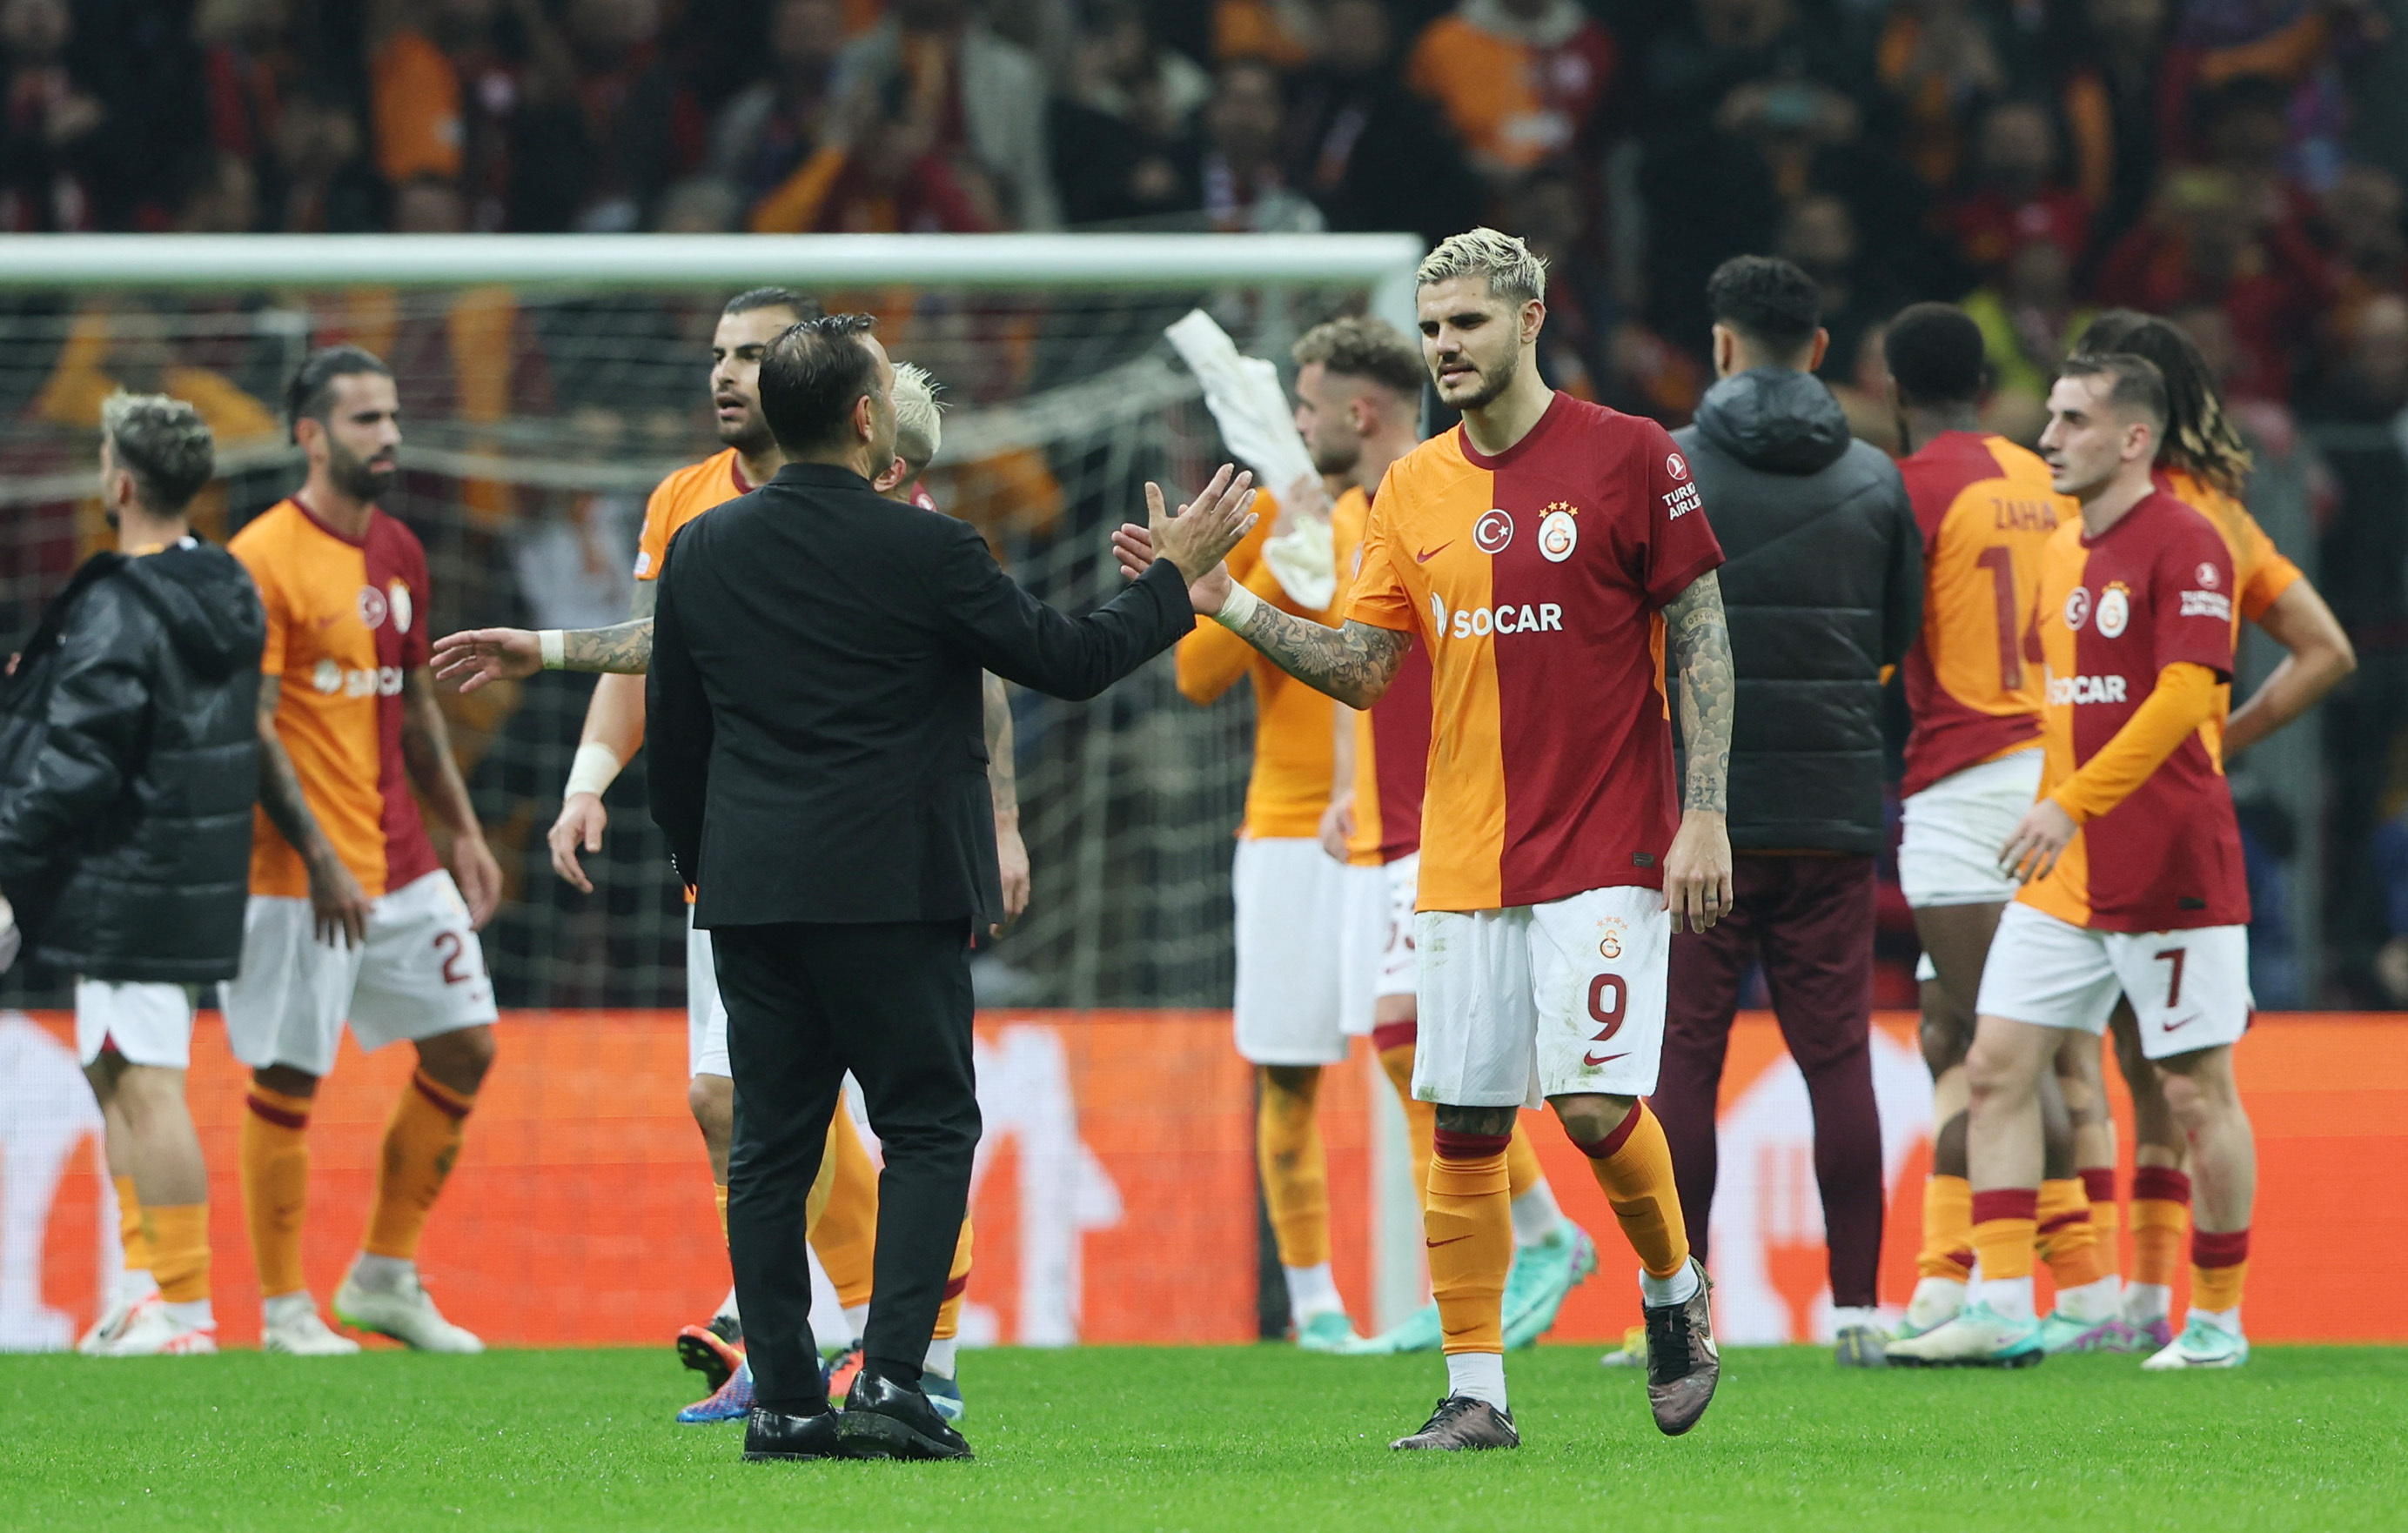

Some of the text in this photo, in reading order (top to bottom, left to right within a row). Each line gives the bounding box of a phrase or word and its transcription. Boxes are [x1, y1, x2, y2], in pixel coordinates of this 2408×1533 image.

[1990, 497, 2059, 532] ZAHA
[1453, 603, 1563, 639] SOCAR
[2050, 674, 2127, 706] SOCAR
[2154, 947, 2186, 1007] 7
[1587, 973, 1628, 1041] 9
